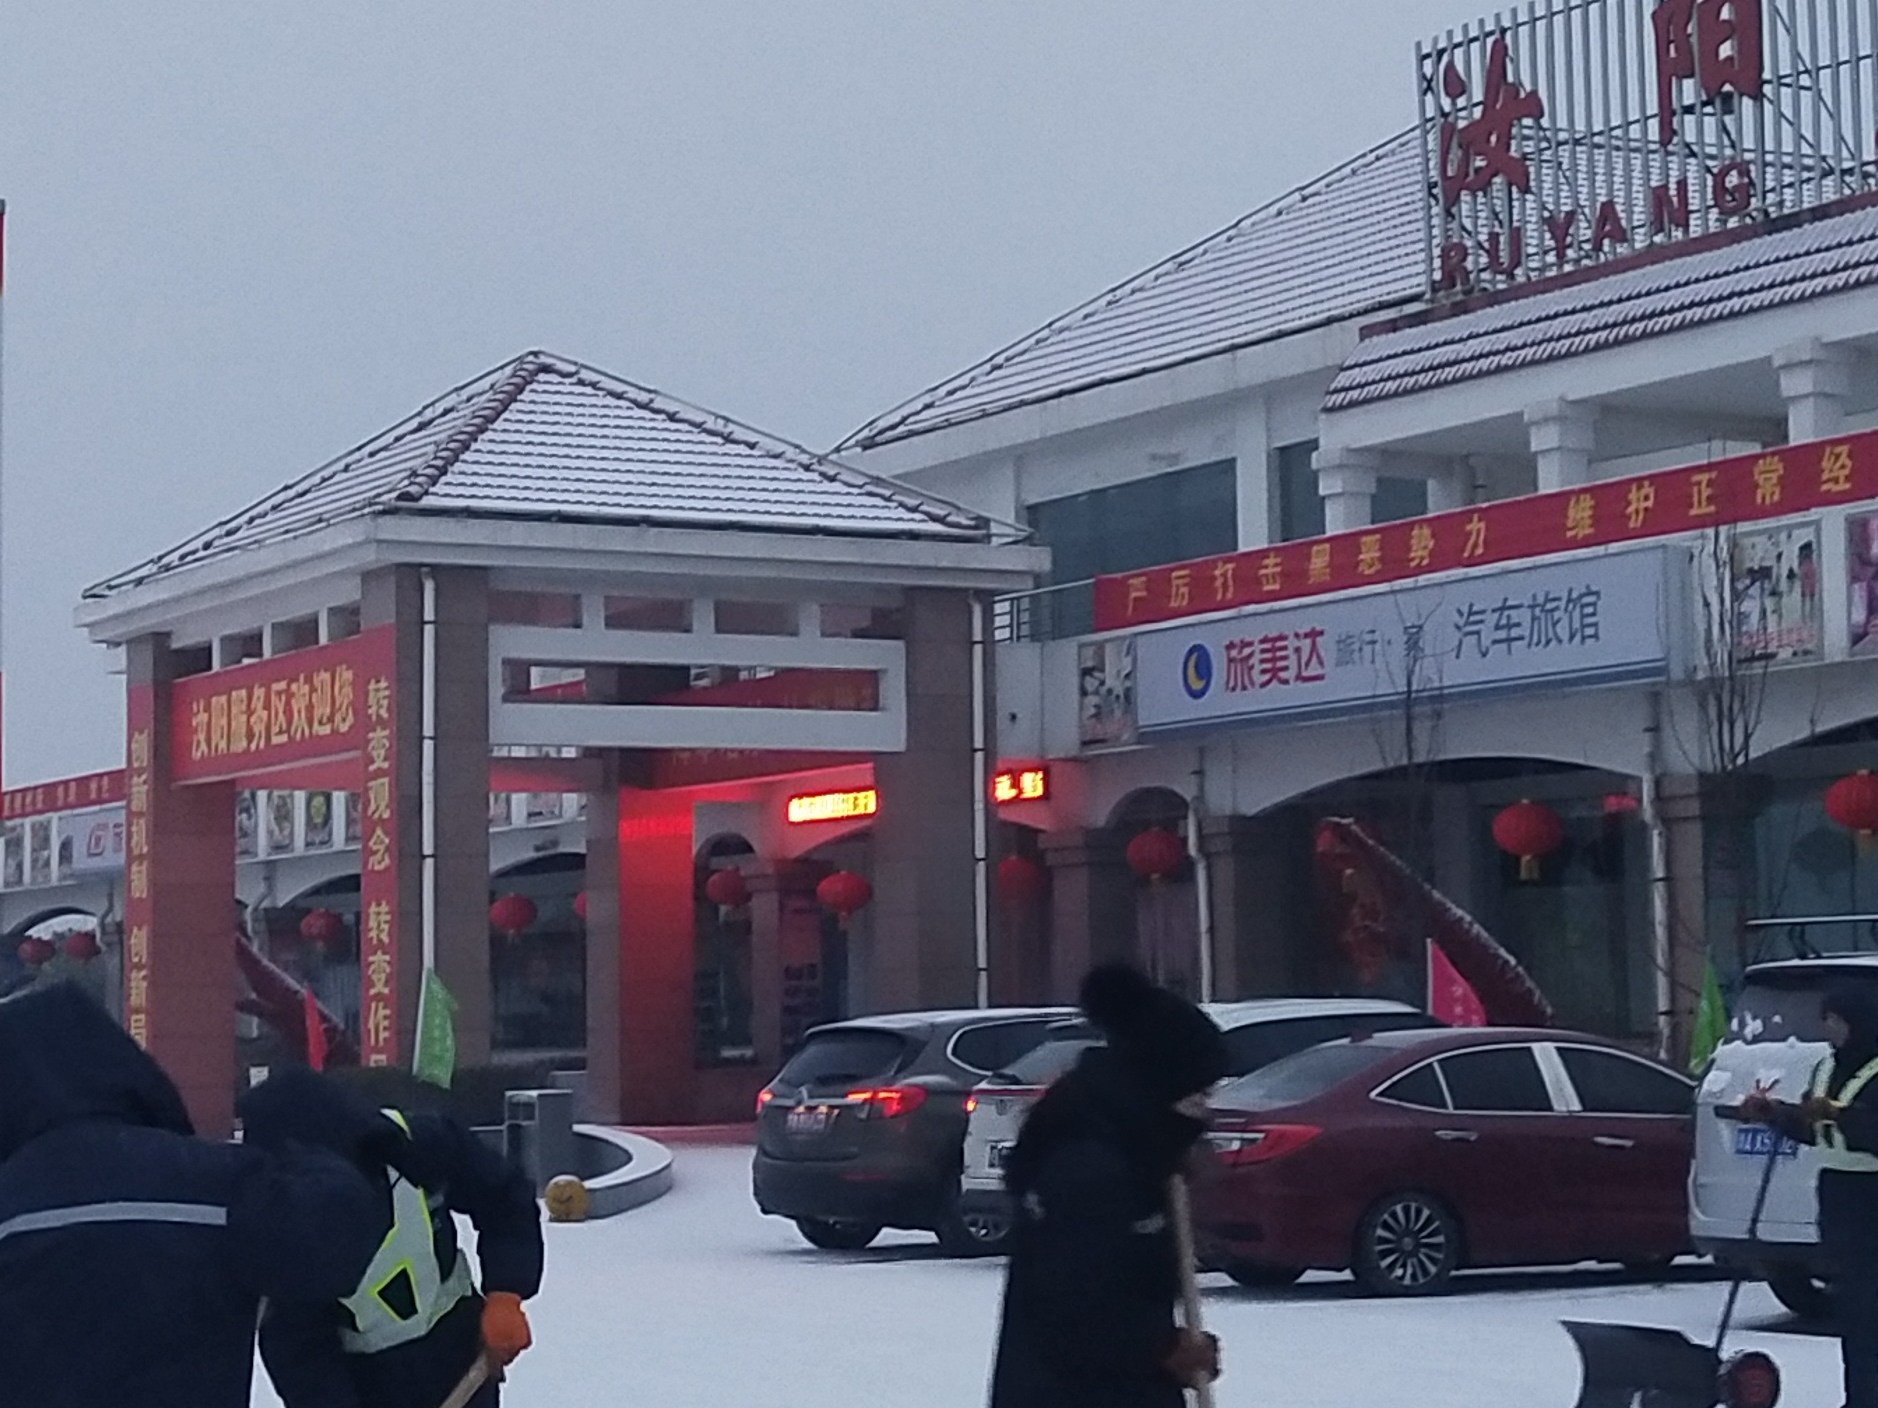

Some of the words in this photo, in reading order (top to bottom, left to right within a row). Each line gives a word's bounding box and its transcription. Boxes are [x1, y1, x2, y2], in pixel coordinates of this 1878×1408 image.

[1439, 161, 1752, 289] RUYANG
[1126, 513, 1487, 617] 严厉打击黑恶势力
[1225, 627, 1326, 692] 旅美达
[1453, 584, 1602, 660] 汽车旅馆
[191, 663, 355, 761] 汝阳服务区欢迎您
[366, 677, 391, 872] 转变观念
